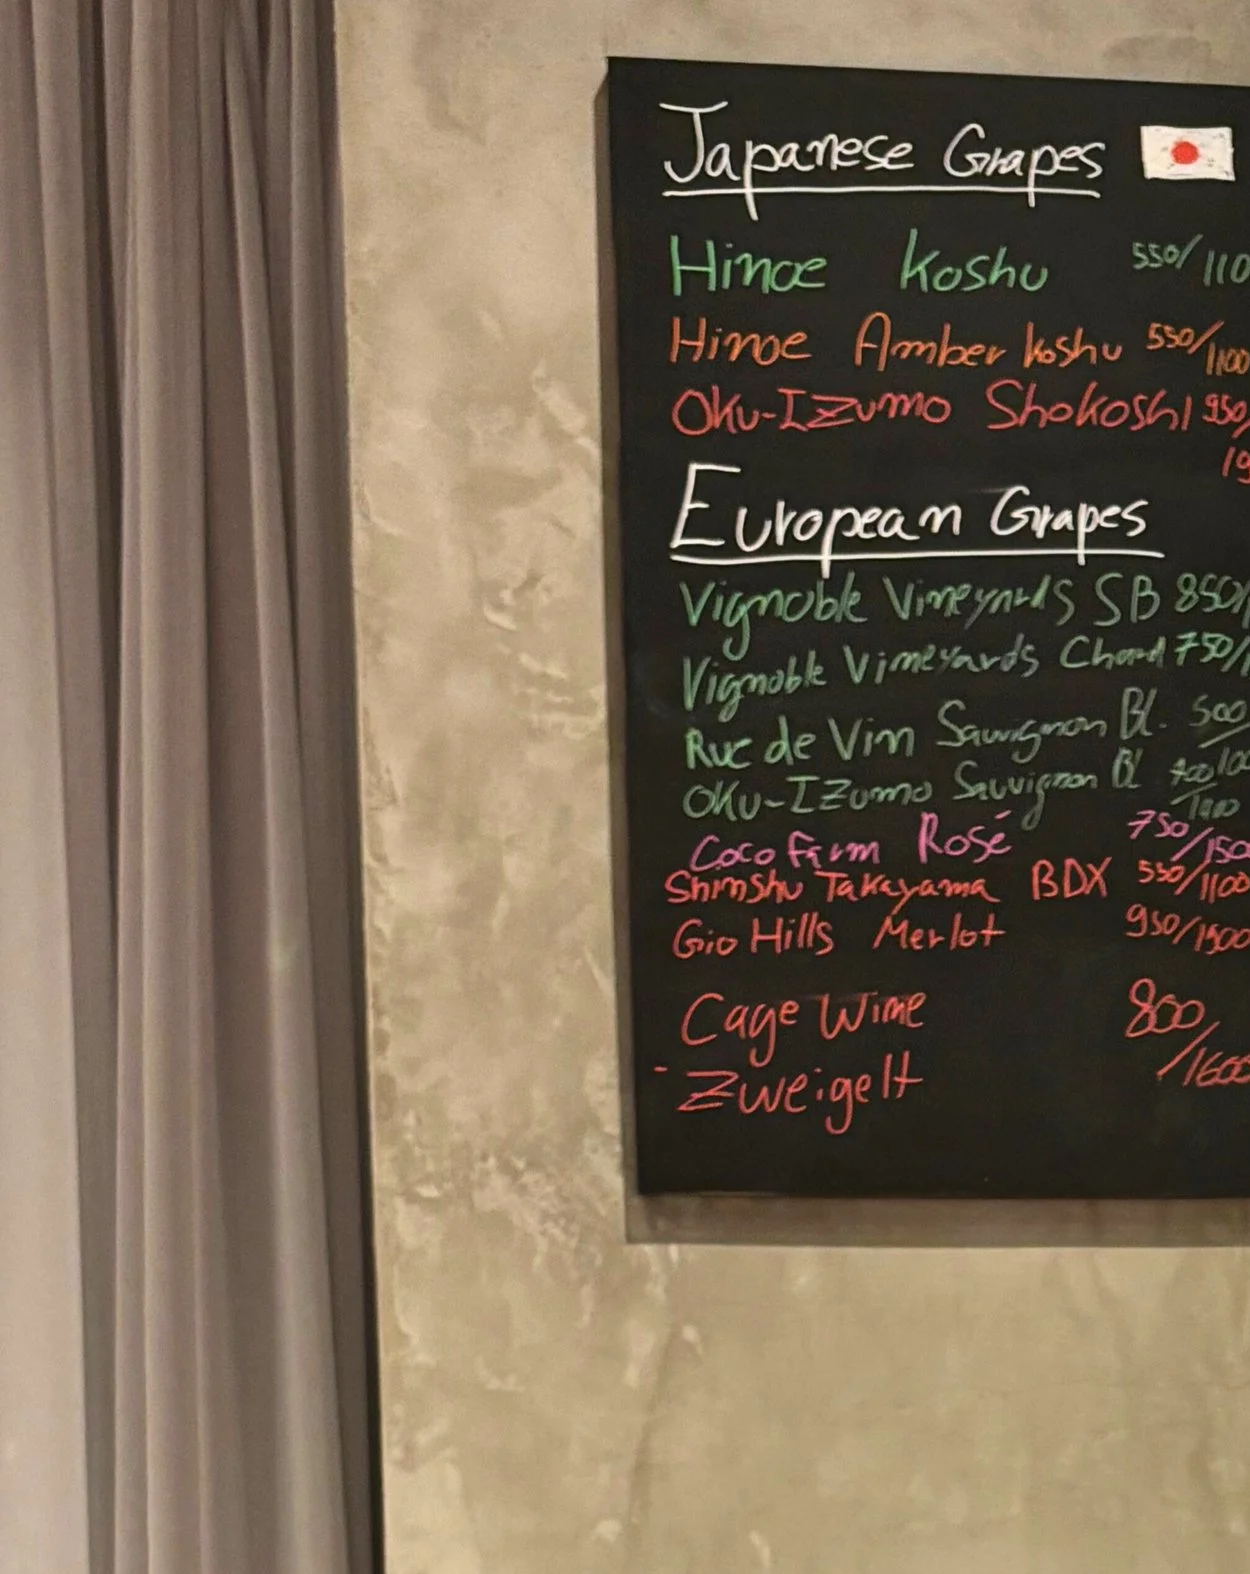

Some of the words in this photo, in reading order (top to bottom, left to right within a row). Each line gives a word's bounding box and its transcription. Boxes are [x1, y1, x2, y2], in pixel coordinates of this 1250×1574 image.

[659, 101, 915, 220] Japanese
[942, 123, 1106, 207] Grapes
[670, 235, 827, 296] Hinoe
[670, 317, 812, 366] Hinoe
[854, 311, 1007, 372] Amber
[670, 462, 963, 579] European
[987, 484, 1153, 566] Grapes
[1092, 571, 1161, 627] SB
[764, 716, 816, 765] de
[919, 811, 1012, 864] Rosé
[1031, 856, 1112, 901] BDX
[750, 911, 834, 956] Hills
[872, 911, 1006, 951] Merlot
[681, 992, 800, 1068] Cage
[819, 992, 926, 1040] Wine
[1125, 977, 1209, 1041] 800
